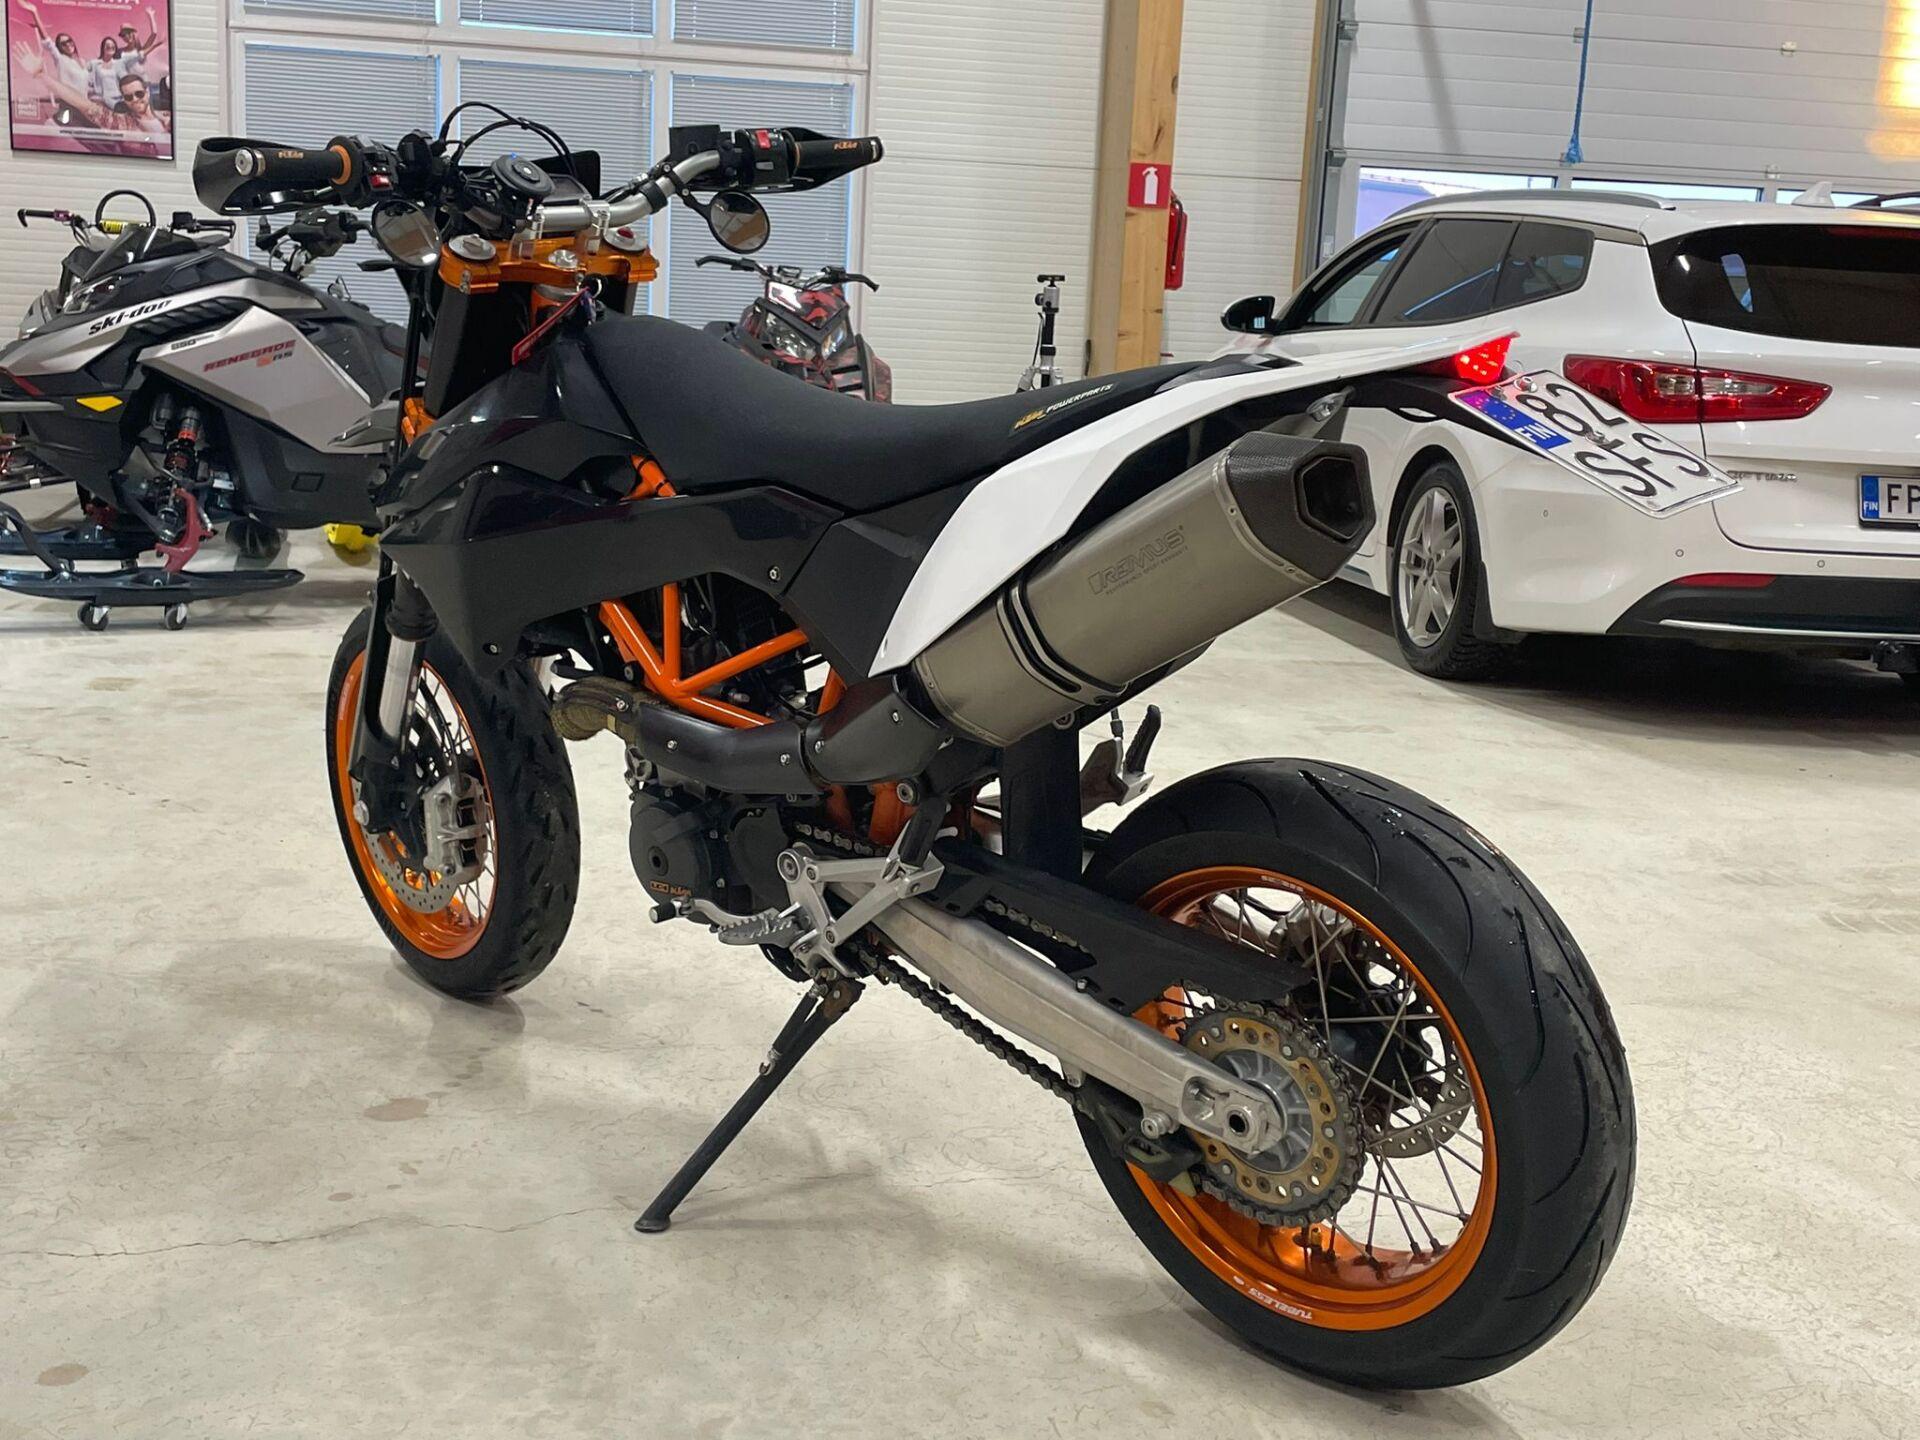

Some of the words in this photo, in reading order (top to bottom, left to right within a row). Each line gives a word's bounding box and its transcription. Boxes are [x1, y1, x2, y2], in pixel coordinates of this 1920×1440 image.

[1046, 383, 1114, 413] POWERPARTS
[1514, 423, 1558, 443] FIN
[1574, 432, 1711, 497] SFS
[1863, 500, 1879, 511] FIN
[1089, 528, 1184, 595] REMUS
